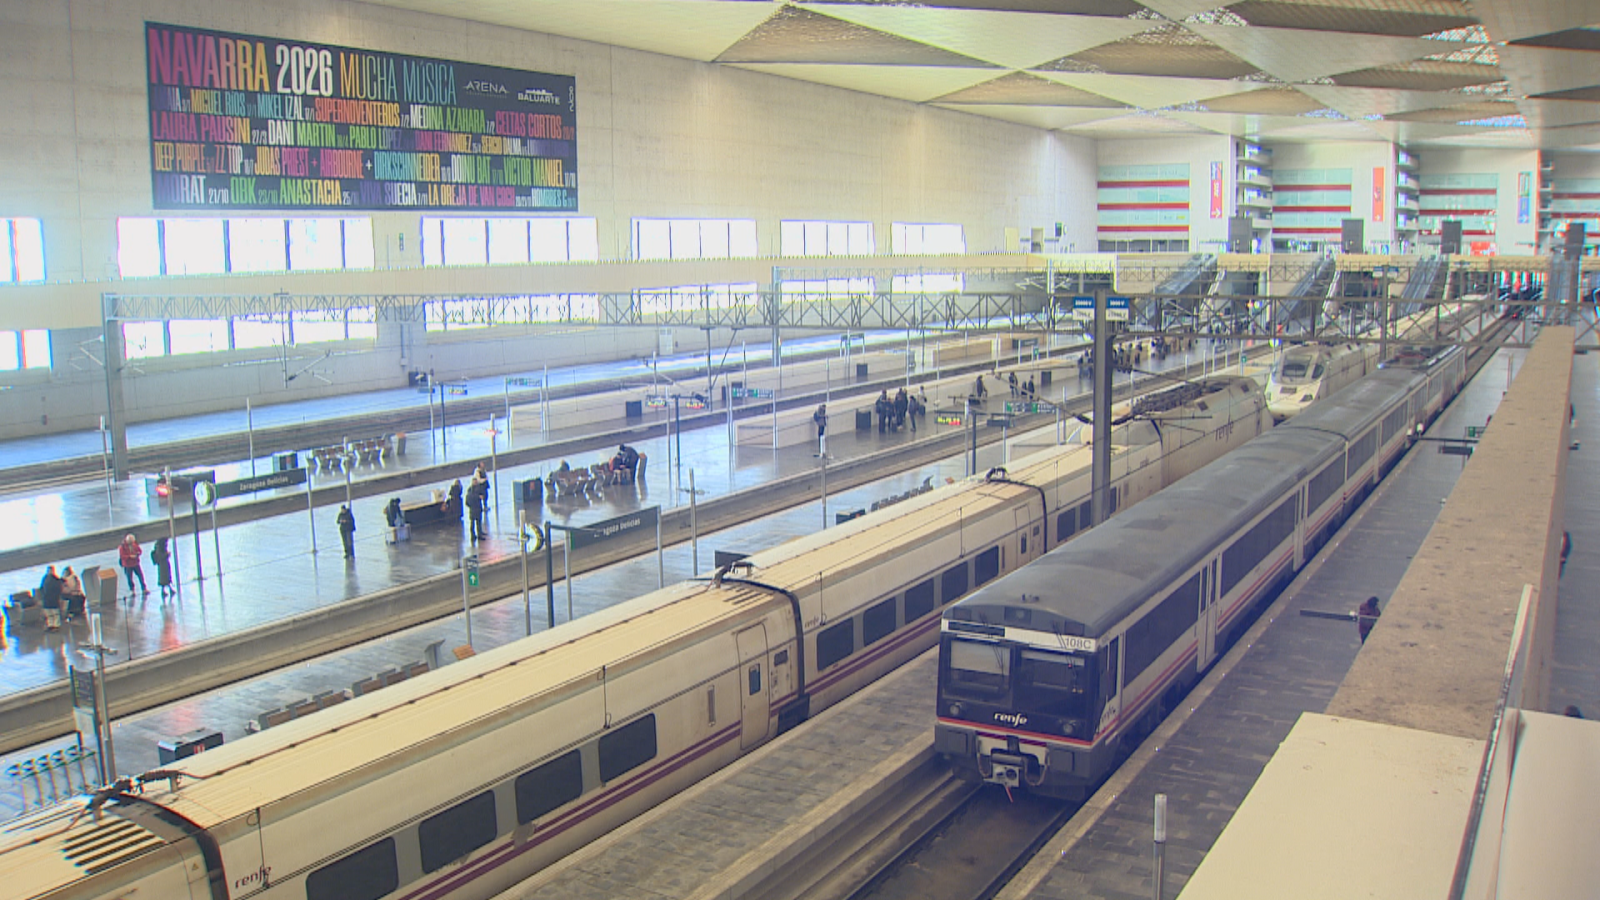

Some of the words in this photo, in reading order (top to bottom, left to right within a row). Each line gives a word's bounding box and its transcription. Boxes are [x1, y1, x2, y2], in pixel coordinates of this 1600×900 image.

[148, 28, 270, 92] NAVARRA
[275, 44, 333, 96] 2026
[340, 51, 398, 102] MUCHA
[403, 59, 457, 105] MÚSICA
[464, 80, 509, 94] ARENA
[517, 92, 560, 105] BALUARTE
[190, 89, 223, 115] MIGUEL
[257, 93, 282, 119] MIKEL
[286, 96, 304, 120] IZAL
[315, 98, 400, 126] SUPERNOVENTEROS
[410, 105, 443, 130] MEDINA
[446, 108, 485, 133] AZAHARA
[496, 110, 525, 136] CELTAS
[528, 114, 561, 139] CORTOS
[153, 110, 197, 141] LAURA
[201, 115, 250, 144] PAUSINI
[252, 130, 267, 145] 27/3
[268, 120, 294, 145] DANI
[349, 125, 377, 149] PABLO
[154, 141, 174, 171] DEEP
[175, 143, 206, 172] PURPLE
[214, 145, 226, 173] ZZ
[228, 145, 243, 174] TOP
[254, 146, 280, 176] JUDAS
[282, 147, 310, 177] PRIEST
[320, 149, 364, 178] AIRBOURNE
[477, 155, 491, 184] BAT
[533, 159, 565, 187] MANUEL
[156, 175, 206, 204] MORAT
[208, 187, 229, 204] 21/10
[231, 177, 256, 204] OBK
[280, 179, 342, 205] ANASTACIA
[360, 180, 382, 205] VIVA
[385, 182, 417, 206] SUECIA
[428, 185, 439, 206] LA
[440, 186, 467, 206] OREJA
[468, 187, 478, 206] DE
[479, 187, 495, 206] VAN
[1065, 637, 1092, 650] 108C
[994, 712, 1028, 727] renfe
[235, 865, 271, 888] renfe
